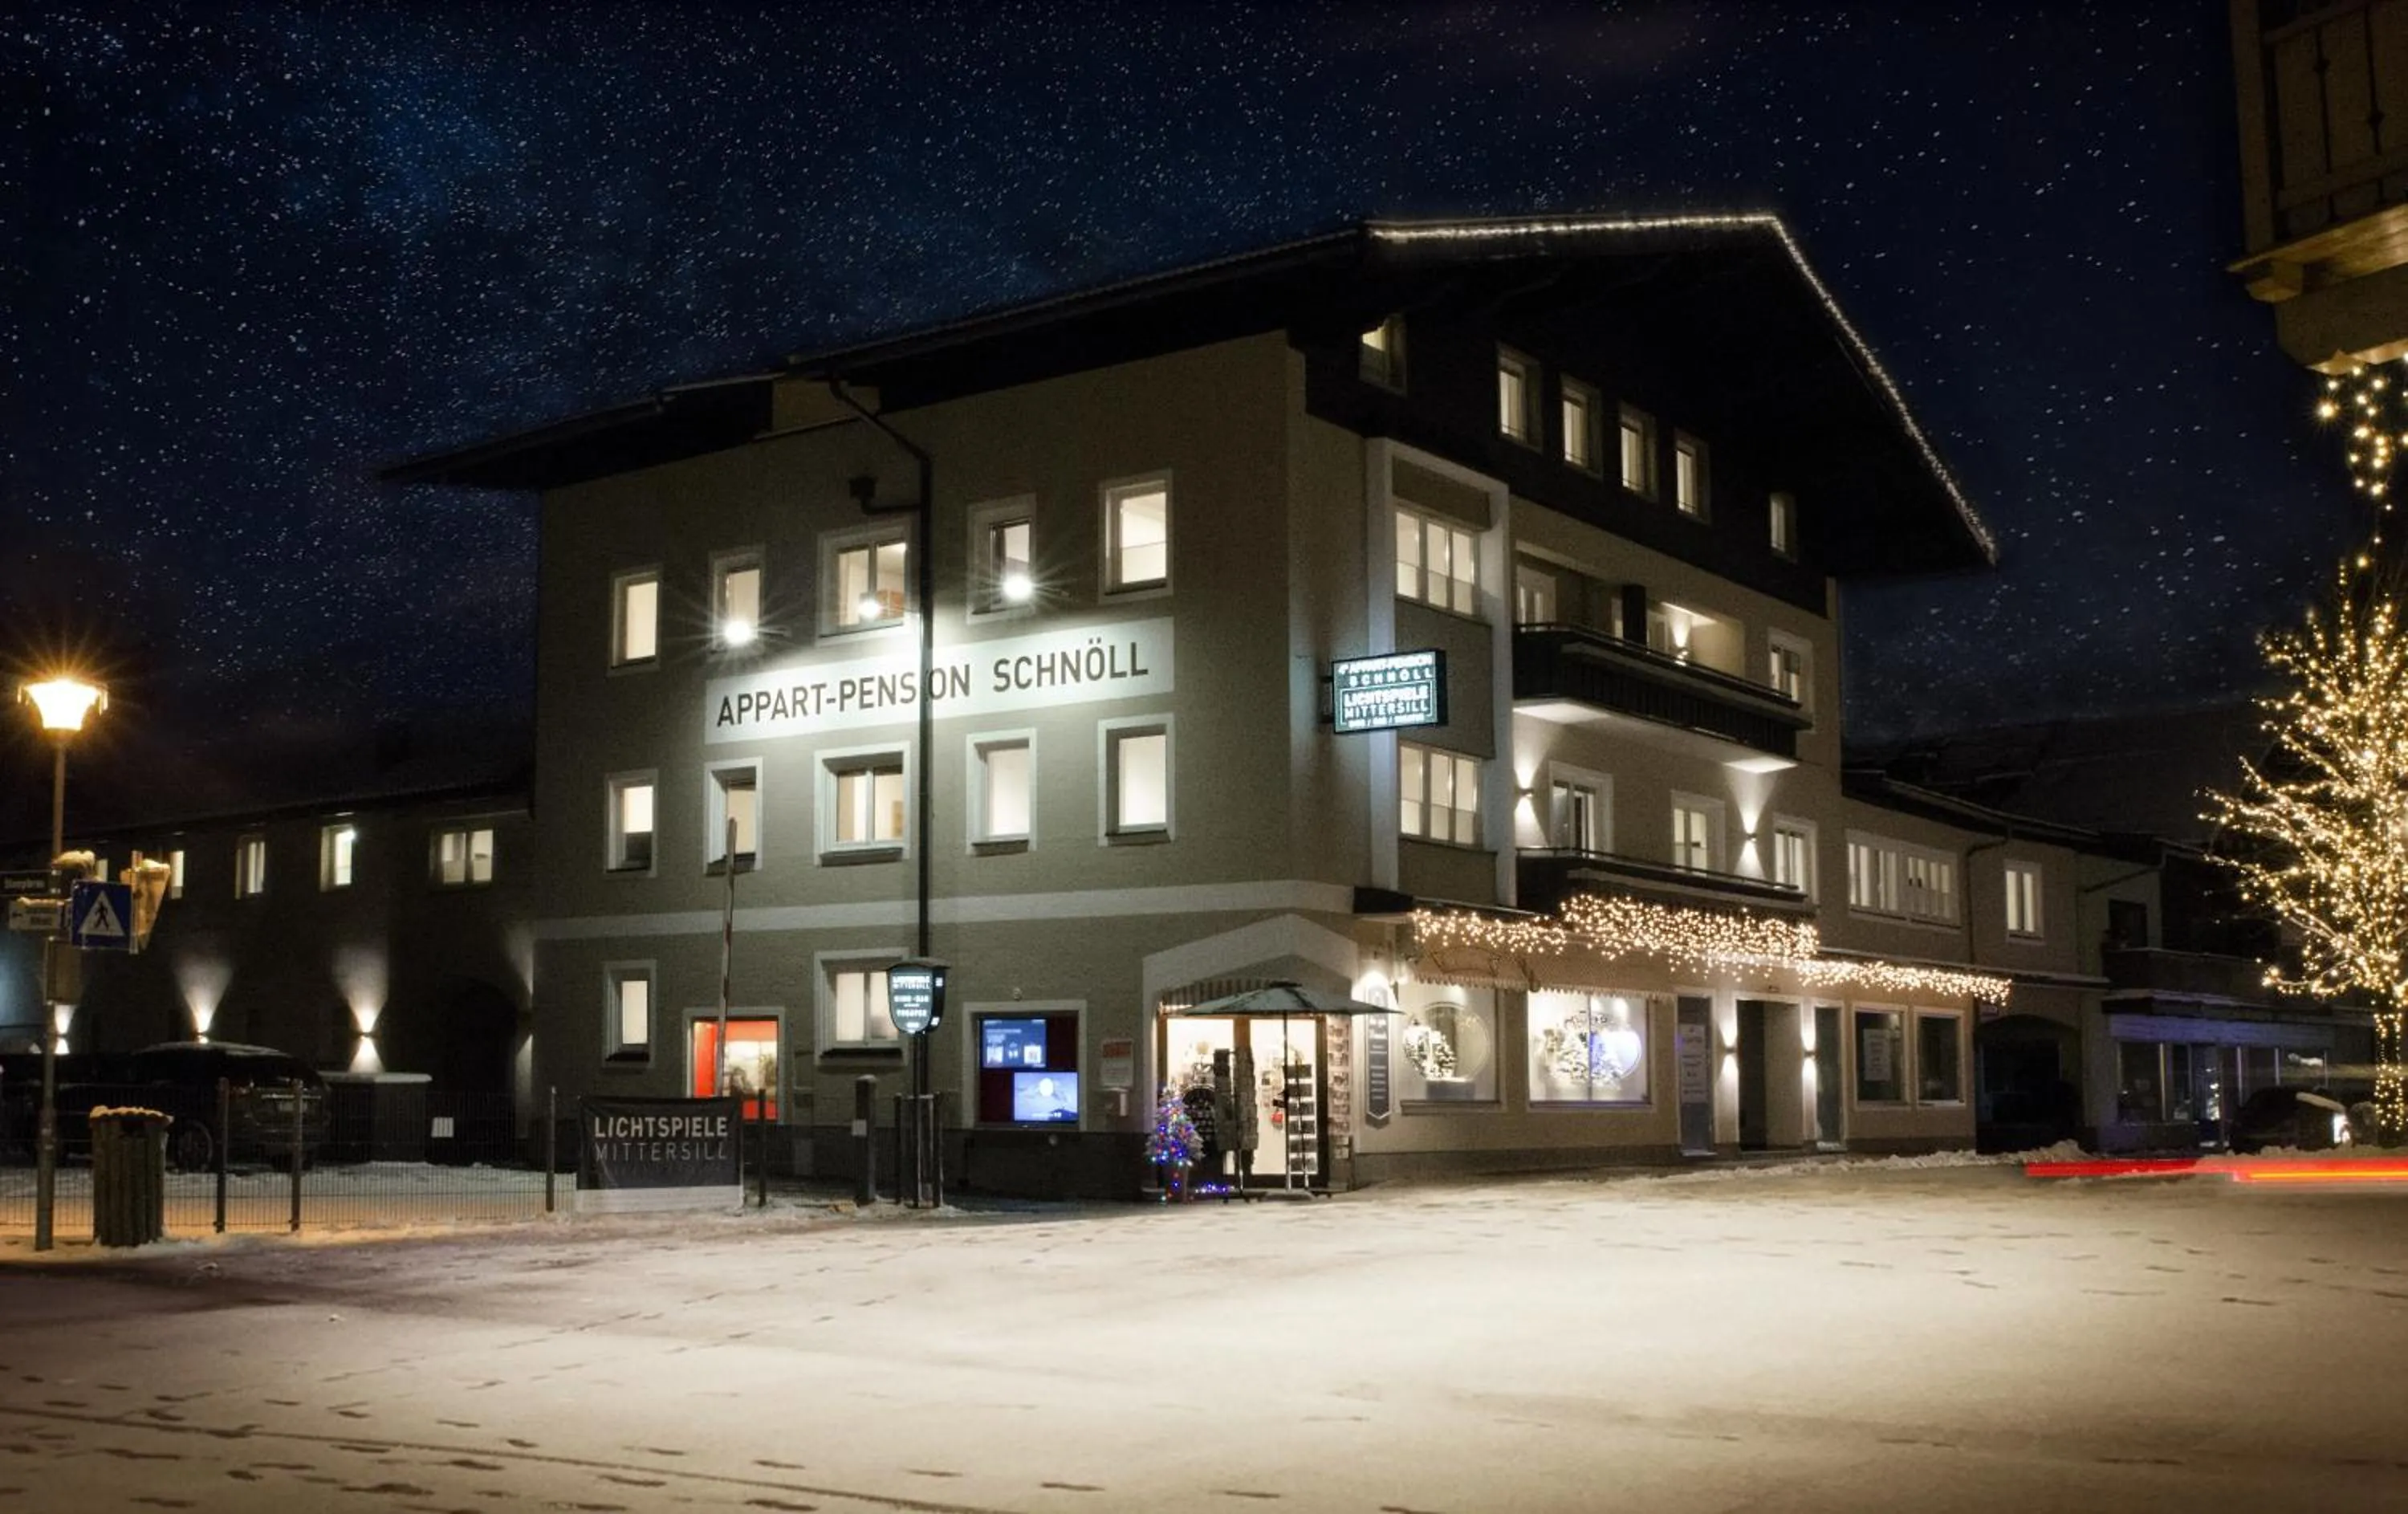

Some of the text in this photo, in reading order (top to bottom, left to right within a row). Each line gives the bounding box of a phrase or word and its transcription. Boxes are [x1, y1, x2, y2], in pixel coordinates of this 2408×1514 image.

[717, 637, 1148, 728] APPART-PENSON SCHNÖLL
[1344, 700, 1428, 718] MITTERSILL
[594, 1117, 729, 1138] LICHTSPIELE
[595, 1142, 728, 1162] MITTERSILL
